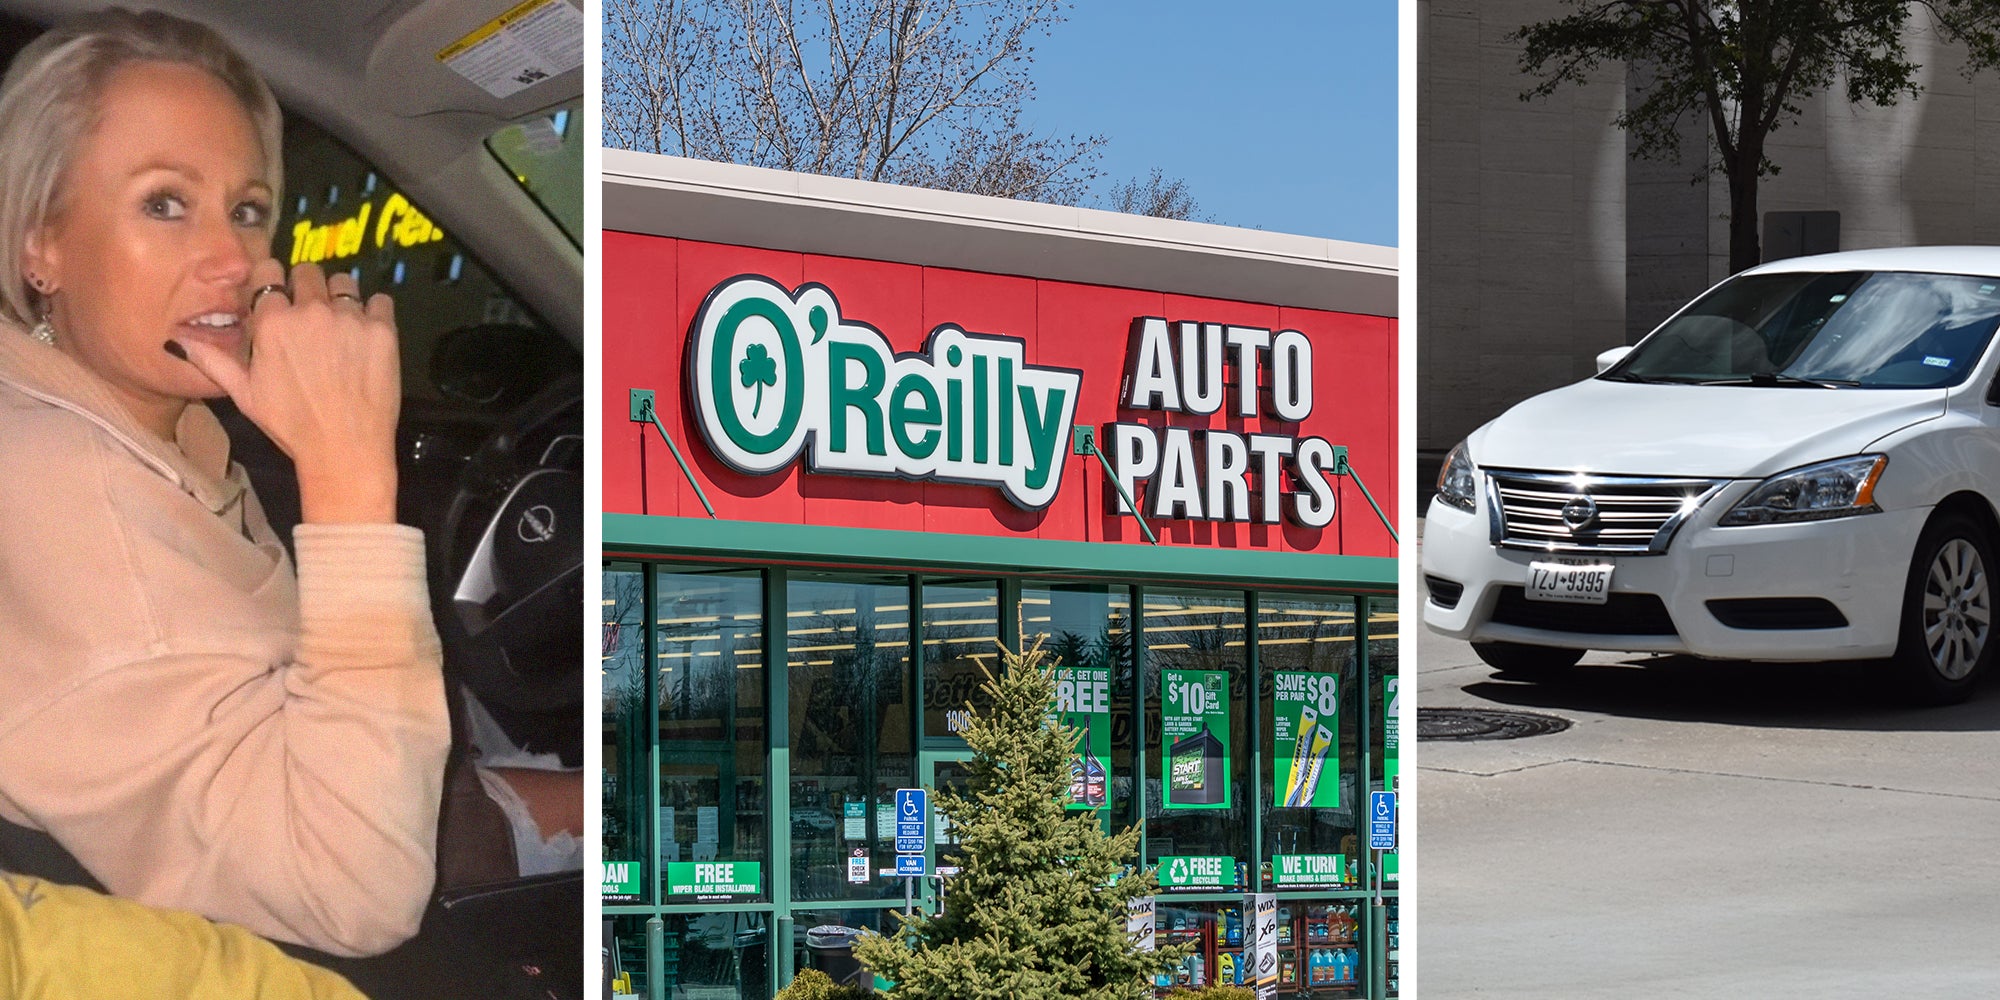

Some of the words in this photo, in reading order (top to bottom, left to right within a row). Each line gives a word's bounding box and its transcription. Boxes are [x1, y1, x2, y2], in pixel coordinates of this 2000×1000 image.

[1131, 318, 1313, 421] AUTO
[711, 297, 1067, 490] O'Reilly
[1115, 423, 1336, 528] PARTS
[1041, 669, 1056, 681] BY
[1077, 671, 1091, 681] GET
[1093, 671, 1108, 681] ONE
[1168, 673, 1177, 682] Get
[1178, 673, 1183, 682] a
[1276, 674, 1306, 692] SAVE
[1169, 682, 1205, 715] $10
[1205, 691, 1217, 701] Gift
[1276, 692, 1289, 701] PER
[1290, 692, 1305, 701] PAIR
[1307, 675, 1336, 717] $8
[1205, 701, 1220, 710] Card
[1174, 759, 1201, 775] START
[695, 863, 734, 884] FREE
[1190, 857, 1222, 876] FREE
[1281, 856, 1302, 875] WE
[1304, 855, 1337, 874] TURN
[1192, 877, 1220, 886] RECYCLING
[1279, 874, 1296, 883] BRAKE
[1297, 874, 1314, 883] DRUMS
[1315, 874, 1319, 883] &
[1320, 874, 1339, 883] ROTORS
[673, 885, 693, 894] WIPER
[694, 885, 714, 894] BLADE
[715, 884, 756, 893] INSTALLATION
[1257, 899, 1275, 913] WIX
[1258, 918, 1276, 942] XP
